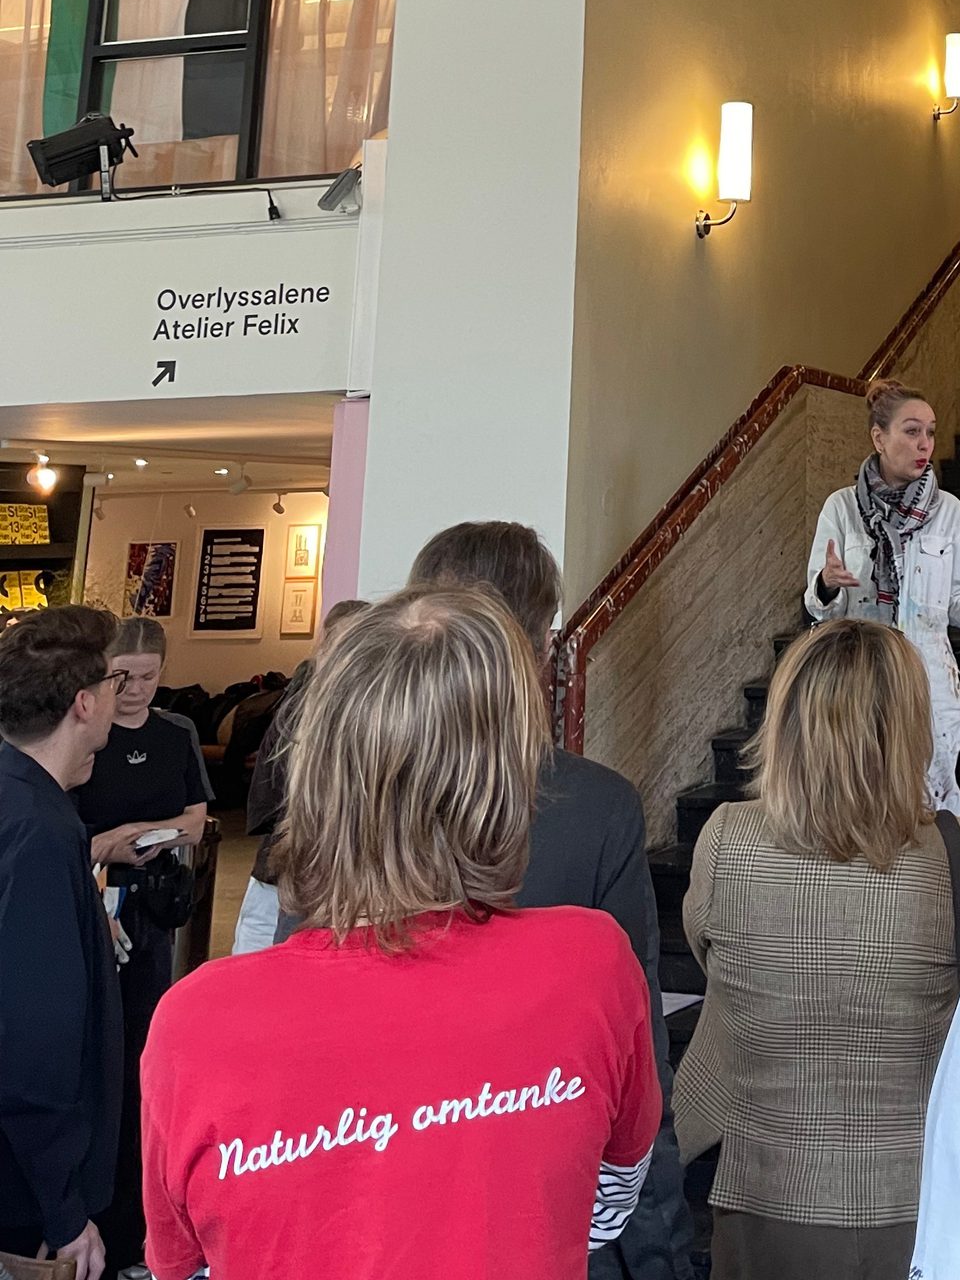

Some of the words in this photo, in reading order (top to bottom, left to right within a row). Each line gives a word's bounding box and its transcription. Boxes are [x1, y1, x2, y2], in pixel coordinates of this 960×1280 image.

[157, 283, 330, 313] Overlyssalene
[153, 317, 235, 340] Atelier
[243, 313, 299, 336] Felix
[206, 545, 211, 554] 1
[204, 555, 211, 564] 2
[203, 565, 209, 574] 3
[202, 575, 208, 584] 4
[201, 586, 207, 595] 5
[200, 596, 206, 605] 6
[199, 605, 206, 614] 7
[217, 1107, 398, 1180] Naturlig
[412, 1066, 586, 1131] omtanke
